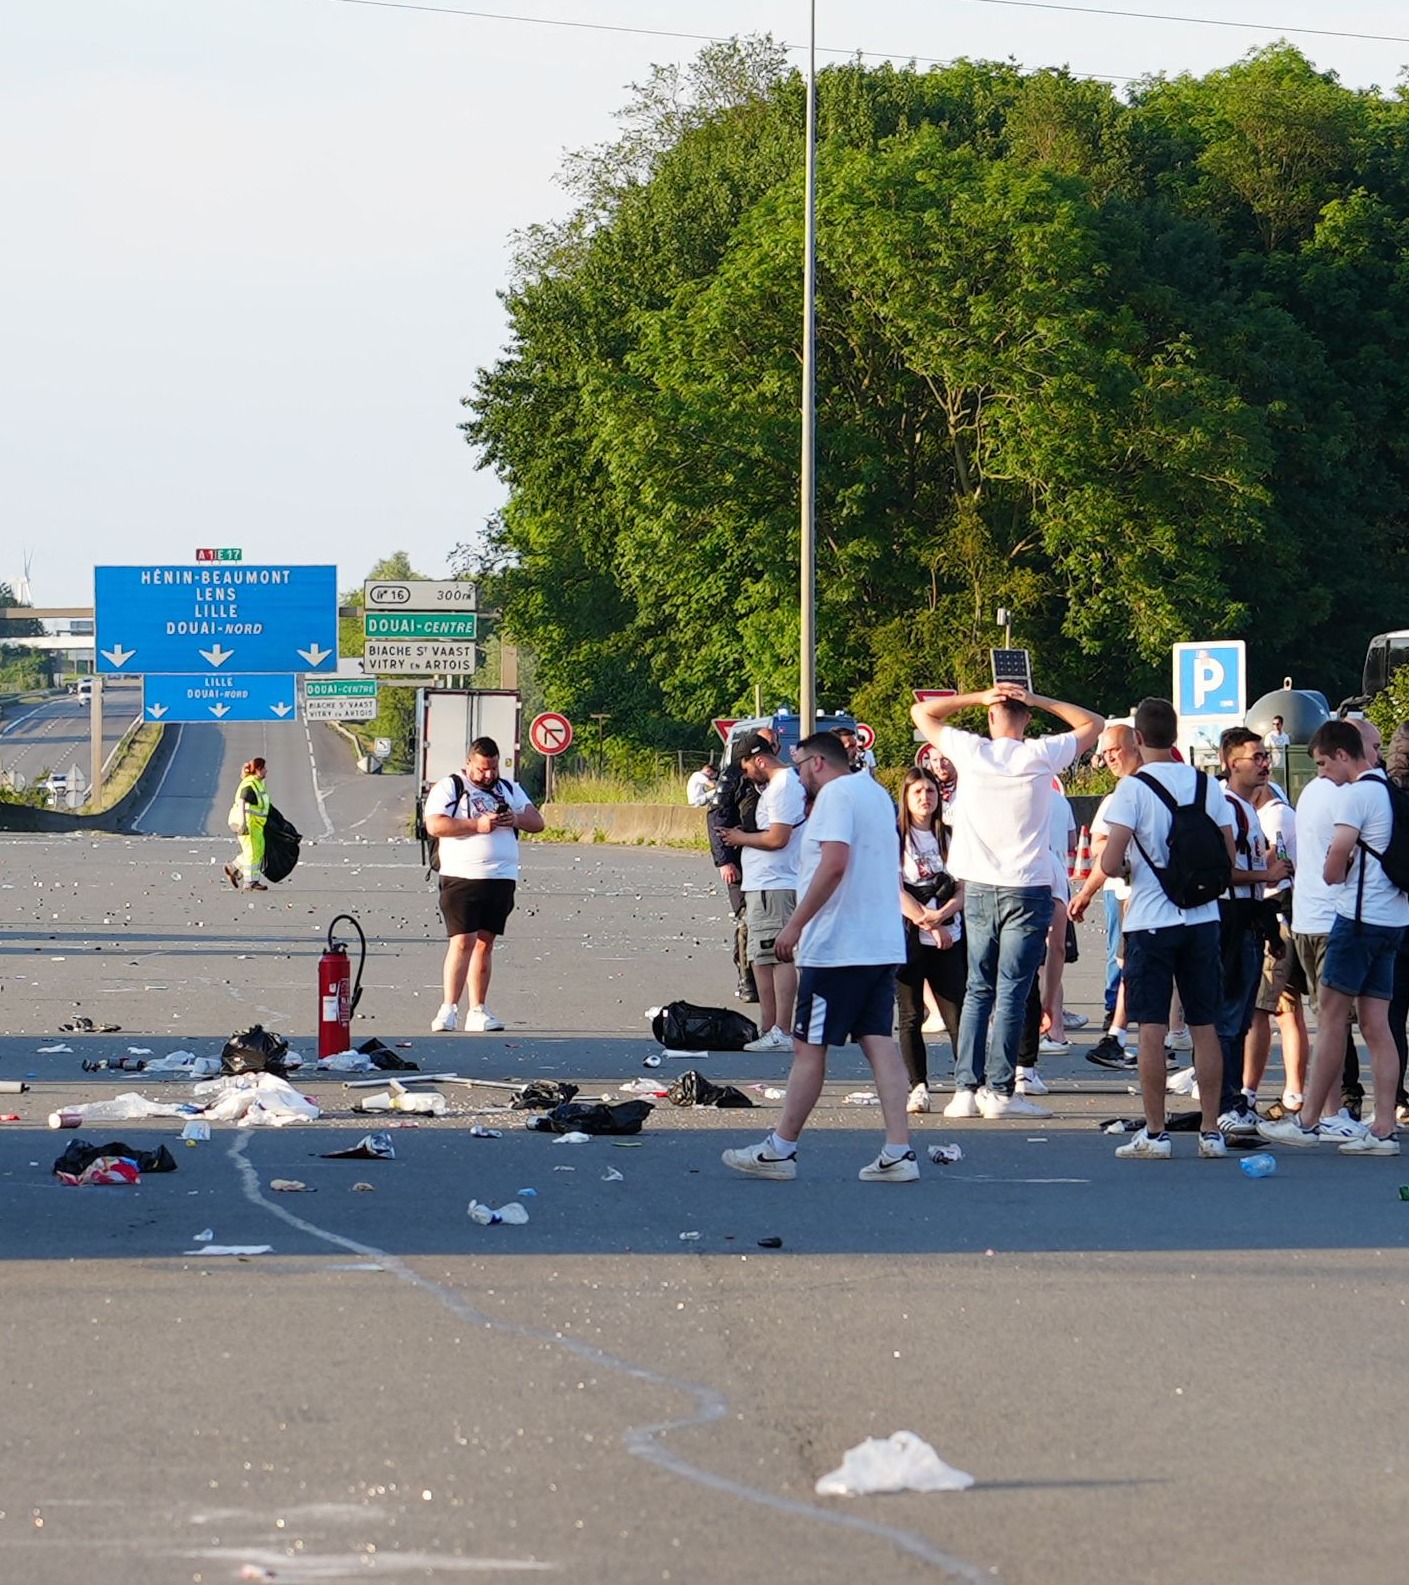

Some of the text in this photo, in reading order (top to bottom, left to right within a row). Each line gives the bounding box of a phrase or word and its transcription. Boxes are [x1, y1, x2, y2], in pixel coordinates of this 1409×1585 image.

[141, 568, 291, 585] HÉNIN-BEAUMONT
[196, 587, 236, 602] LENS
[391, 590, 405, 600] 16
[194, 604, 238, 618] LILLE
[166, 621, 263, 635] DOUAI-NORD
[368, 619, 473, 633] DOUAI-CENTRE
[369, 645, 412, 656] BIACHE
[432, 646, 470, 657] VAAST
[369, 659, 405, 669] VITRY
[425, 660, 471, 670] ARTOIS
[204, 677, 233, 687] LILLE
[1193, 658, 1225, 709] P
[187, 688, 249, 699] DOUAI-NORD
[307, 684, 374, 695] DOUAI-CENTRE
